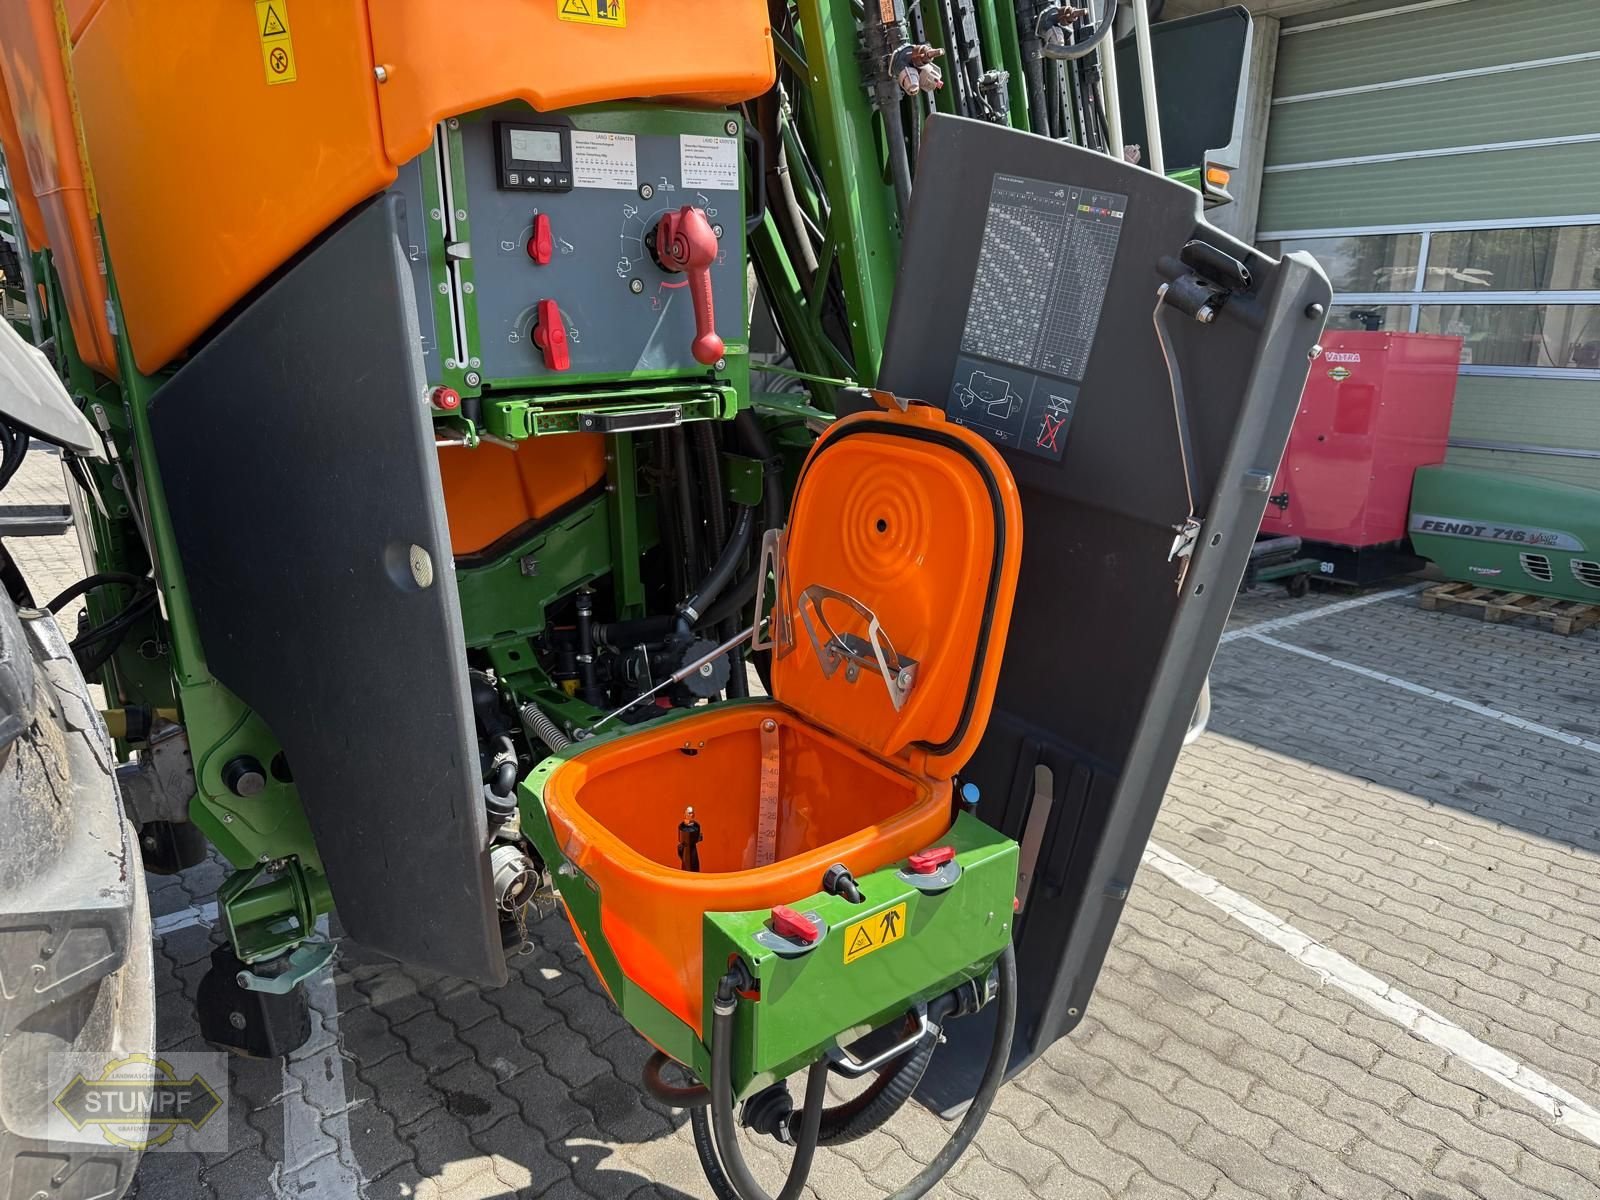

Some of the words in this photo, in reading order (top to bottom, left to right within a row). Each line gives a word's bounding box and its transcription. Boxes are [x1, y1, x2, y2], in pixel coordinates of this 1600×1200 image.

[1326, 352, 1360, 361] VALTRA
[1421, 520, 1487, 536] FENDT
[1493, 528, 1527, 541] 716
[768, 768, 779, 776] 40
[766, 829, 776, 838] 20
